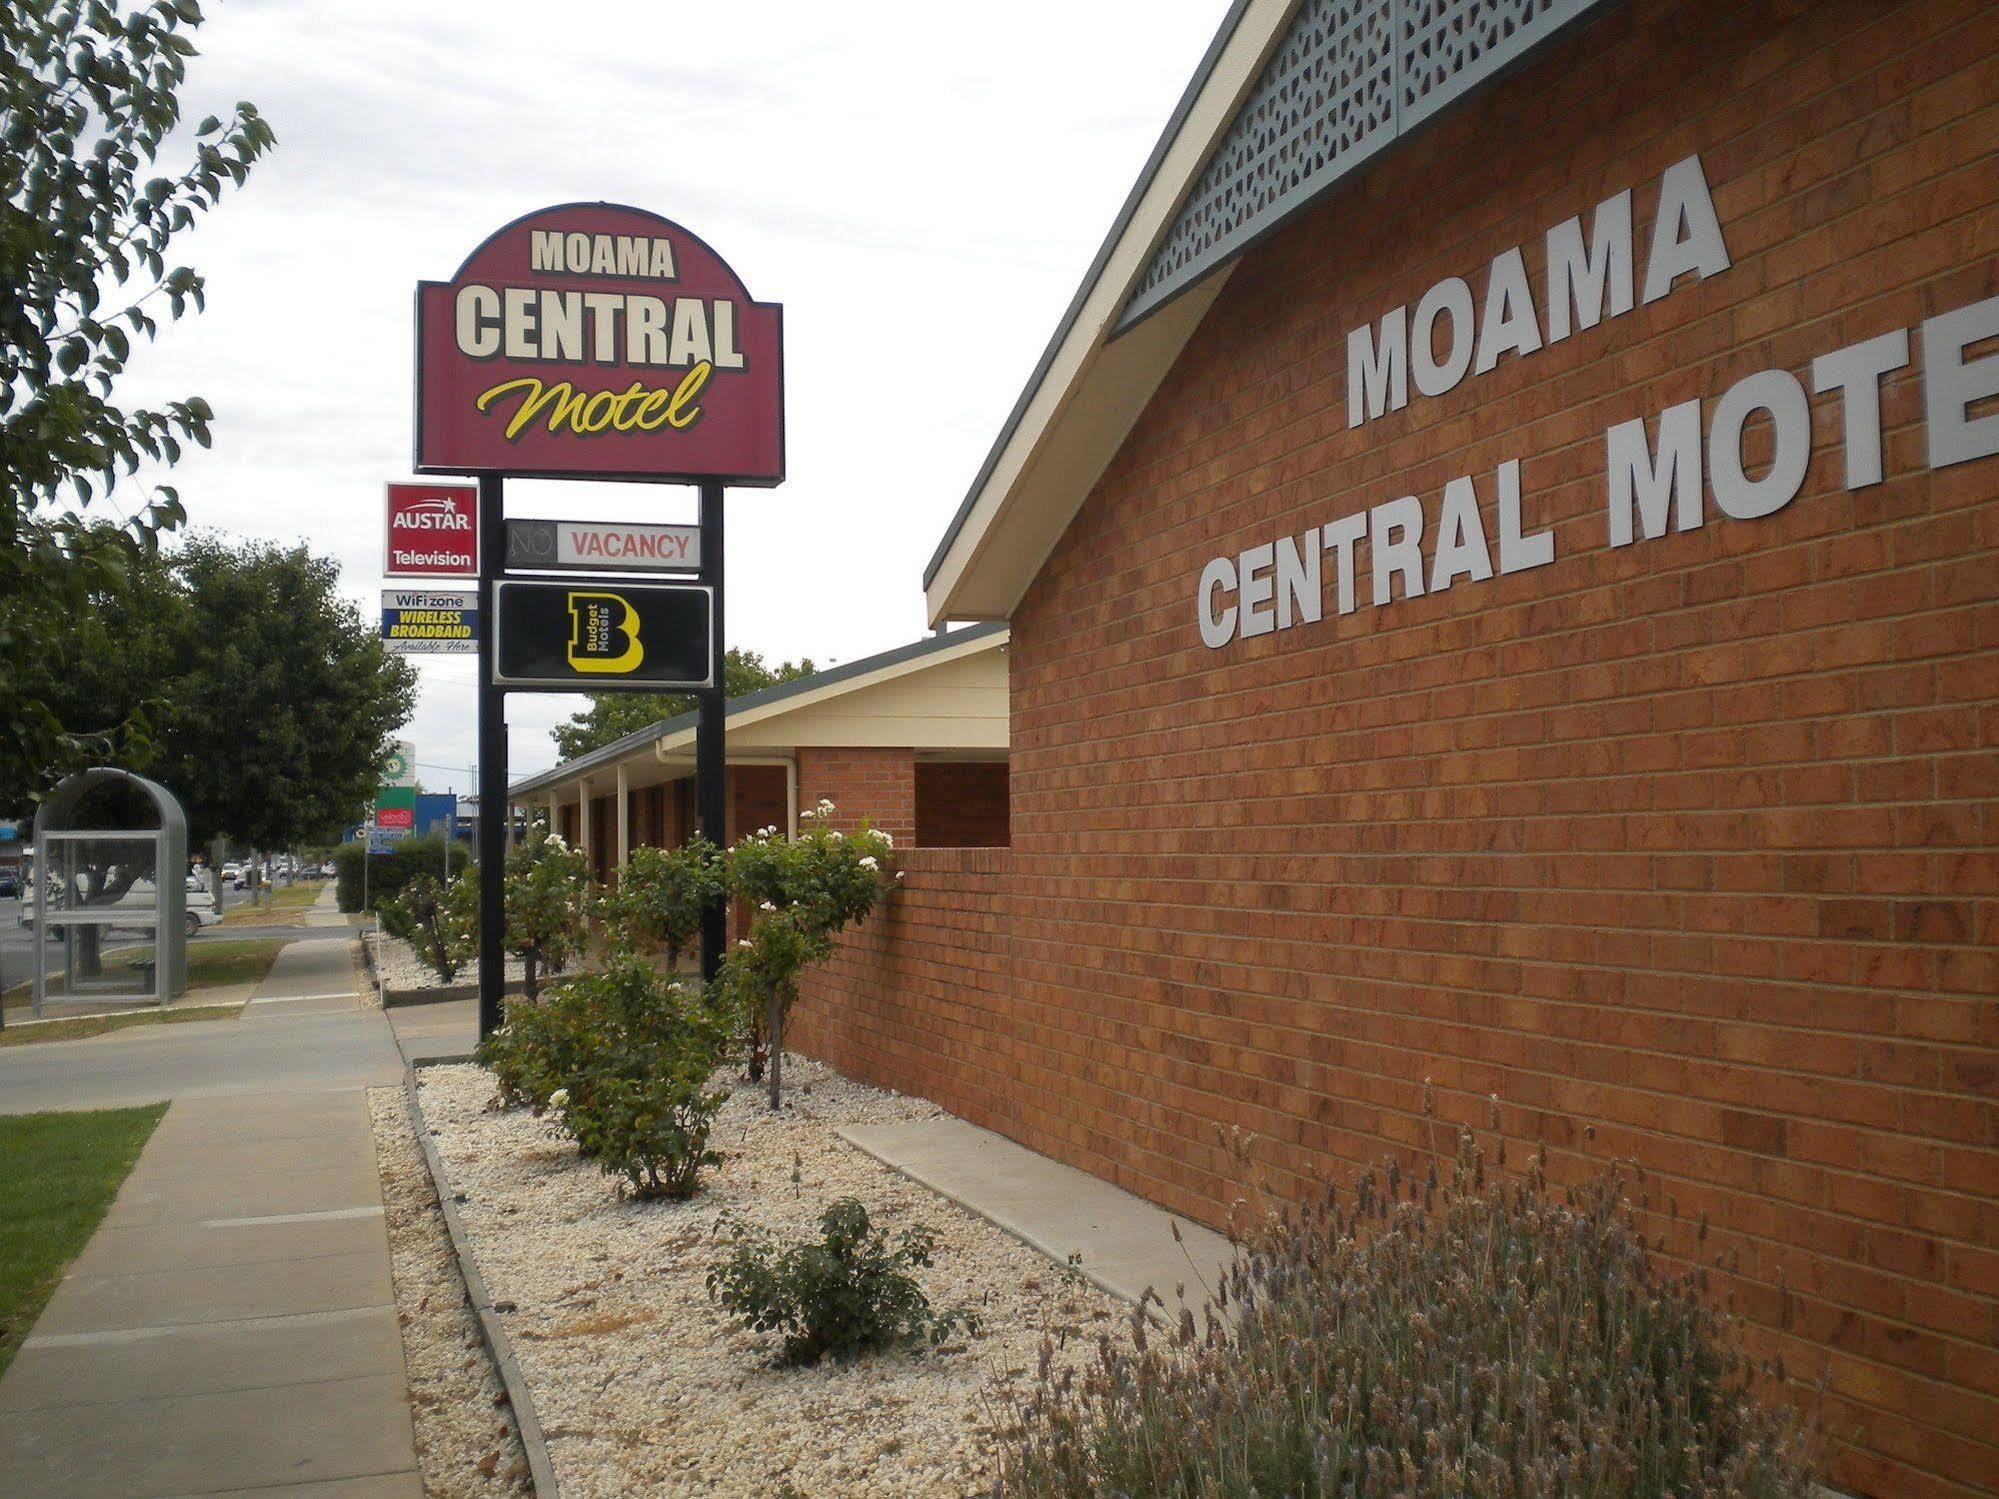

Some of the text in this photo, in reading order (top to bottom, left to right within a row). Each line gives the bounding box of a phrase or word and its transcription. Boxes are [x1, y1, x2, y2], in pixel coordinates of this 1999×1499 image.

[531, 230, 676, 280] MOAMA
[1347, 152, 1731, 430] MOAMA
[455, 284, 744, 368] CENTRAL
[1197, 296, 1999, 650] CENTRAL MOTE
[392, 549, 471, 566] Television
[511, 527, 691, 559] NO VACANCY
[399, 610, 462, 624] WIRELESS
[429, 597, 464, 607] zone
[390, 624, 472, 638] BROADBAND
[393, 640, 470, 653] Available Here
[587, 603, 600, 652] Budget
[597, 607, 609, 652] Motels
